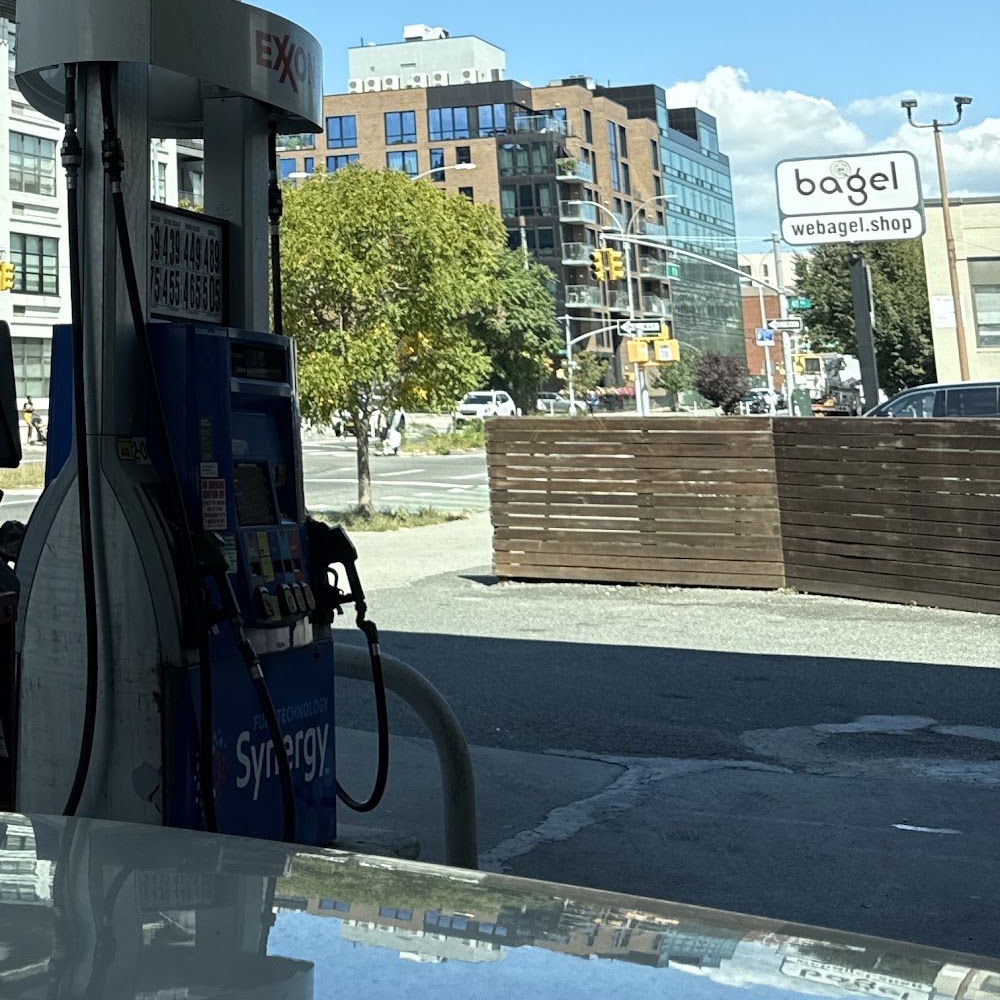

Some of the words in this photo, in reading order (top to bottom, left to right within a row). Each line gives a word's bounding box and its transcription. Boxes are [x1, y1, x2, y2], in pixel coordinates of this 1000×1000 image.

[794, 161, 899, 206] bagel
[791, 215, 912, 237] webagel.shop
[277, 696, 329, 724] TECHNOLOGY
[236, 723, 329, 801] Synergy
